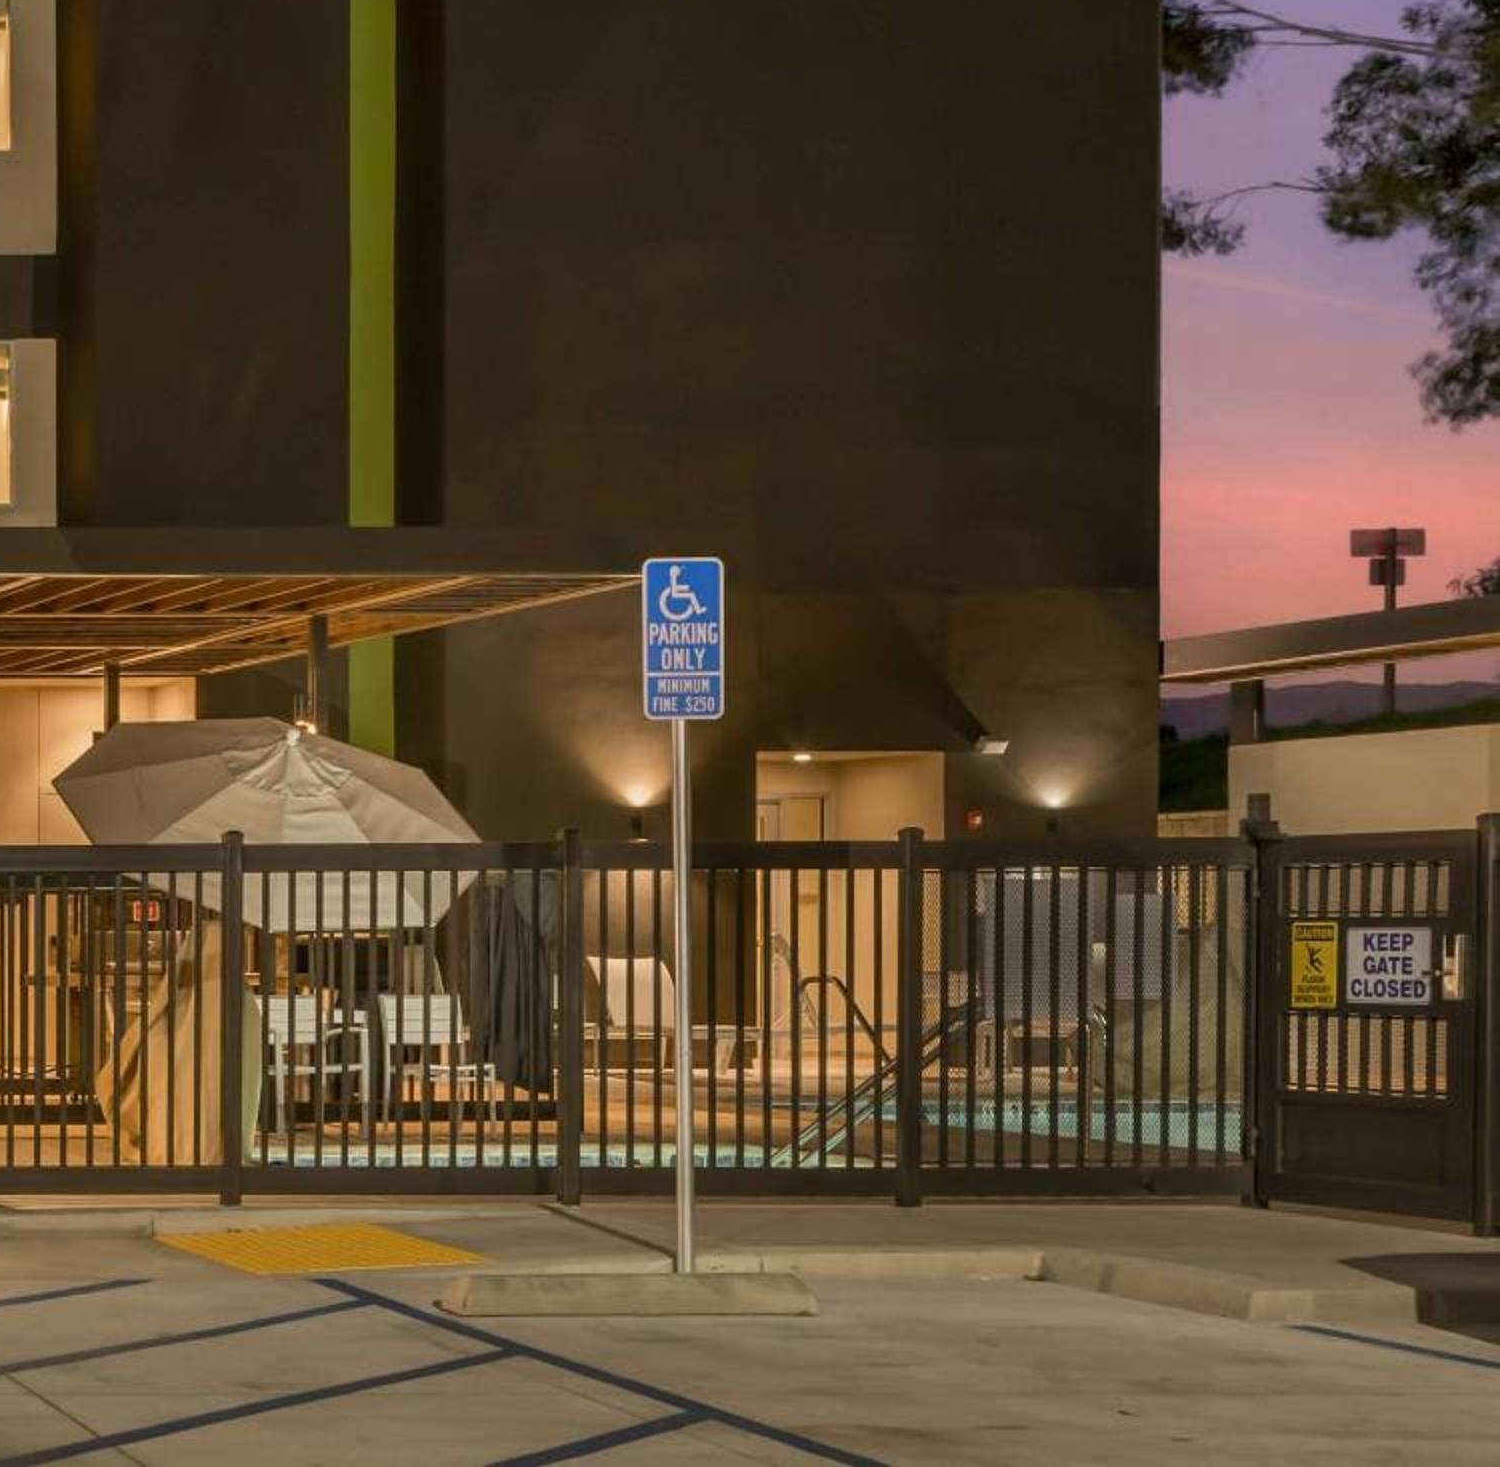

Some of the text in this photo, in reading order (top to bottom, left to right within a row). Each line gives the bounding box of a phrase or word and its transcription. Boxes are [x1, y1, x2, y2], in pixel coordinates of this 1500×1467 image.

[649, 622, 719, 645] PARKING
[661, 647, 706, 670] ONLY
[657, 678, 710, 694] MINIMUM
[653, 695, 715, 713] FINE $250
[1363, 933, 1414, 951] KEEP
[1363, 956, 1413, 975] GATE
[1351, 979, 1426, 998] CLOSED
